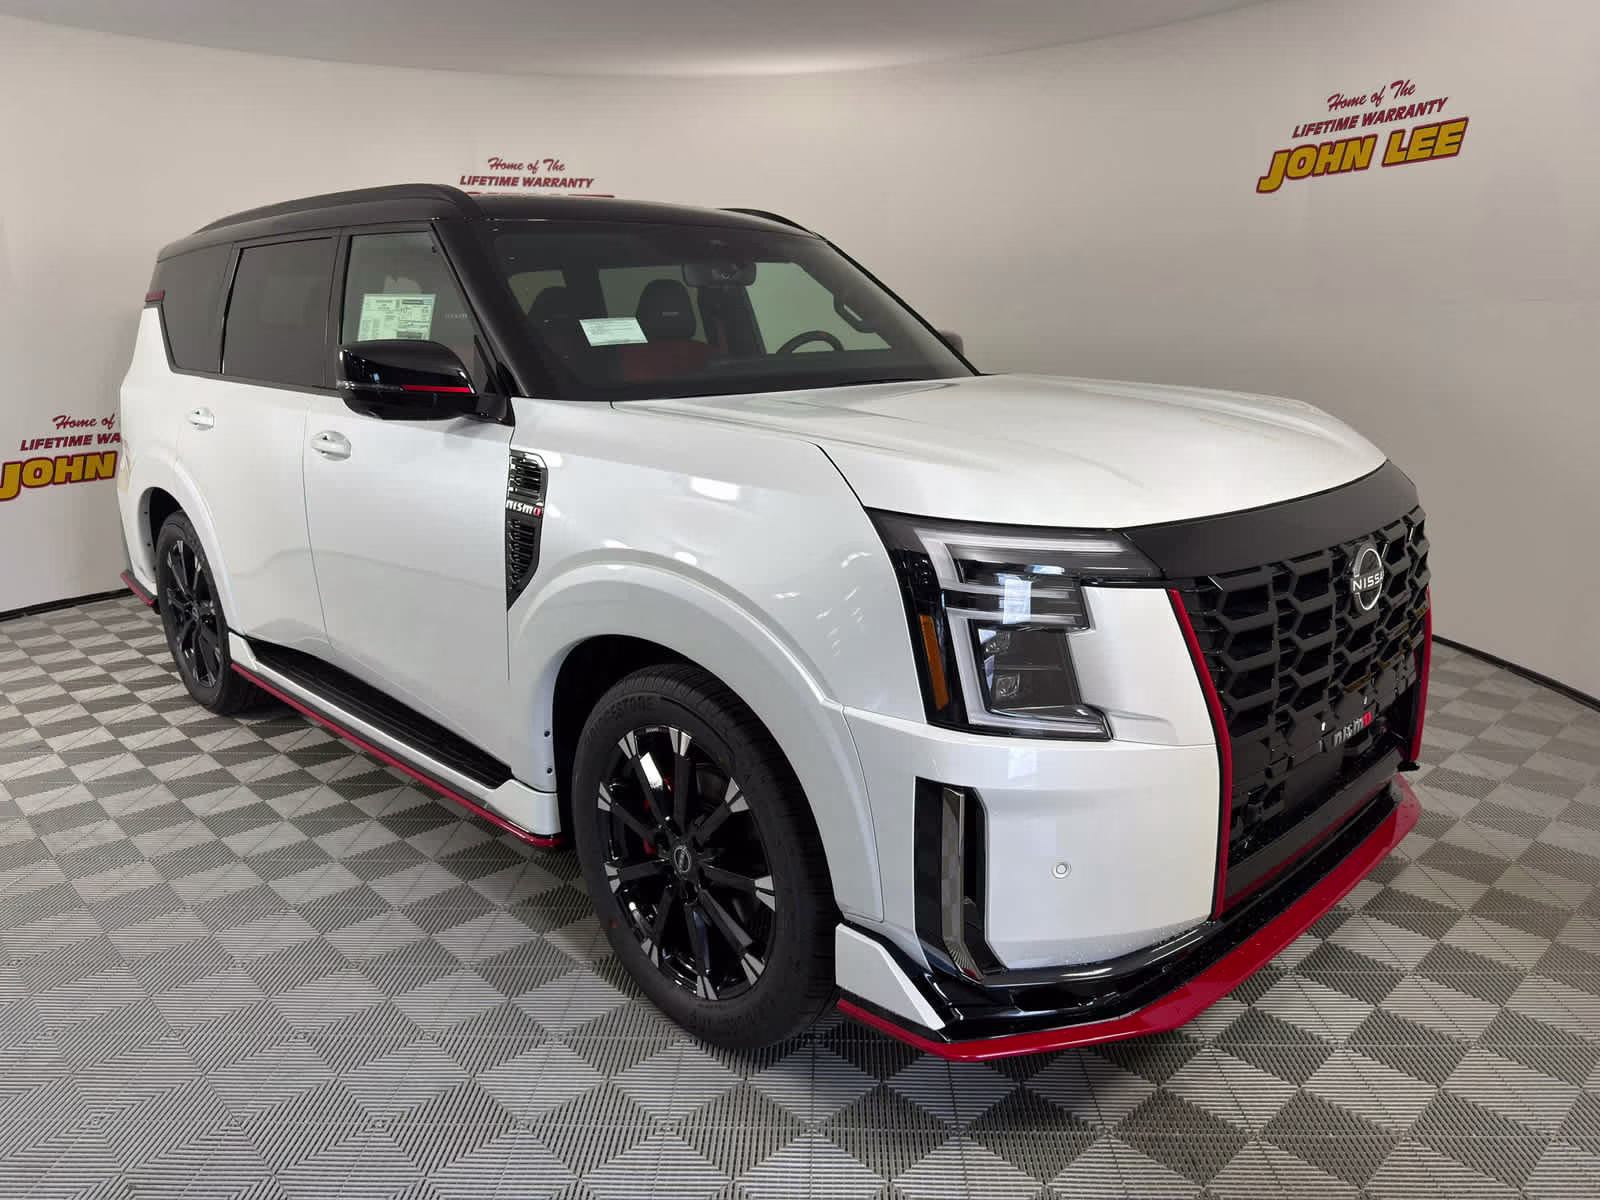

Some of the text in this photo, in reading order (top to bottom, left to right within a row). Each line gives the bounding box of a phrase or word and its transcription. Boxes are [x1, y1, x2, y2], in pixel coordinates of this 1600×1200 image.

[1328, 79, 1416, 112] Home of The
[1292, 97, 1448, 138] LIFETIME WARRANTY
[488, 157, 566, 174] Home of The
[1256, 117, 1469, 193] JOHN LEE
[460, 176, 594, 188] LIFETIME WARRANTY
[53, 413, 115, 430] Home of
[20, 434, 93, 451] LIFETIME
[0, 450, 118, 502] JOHN
